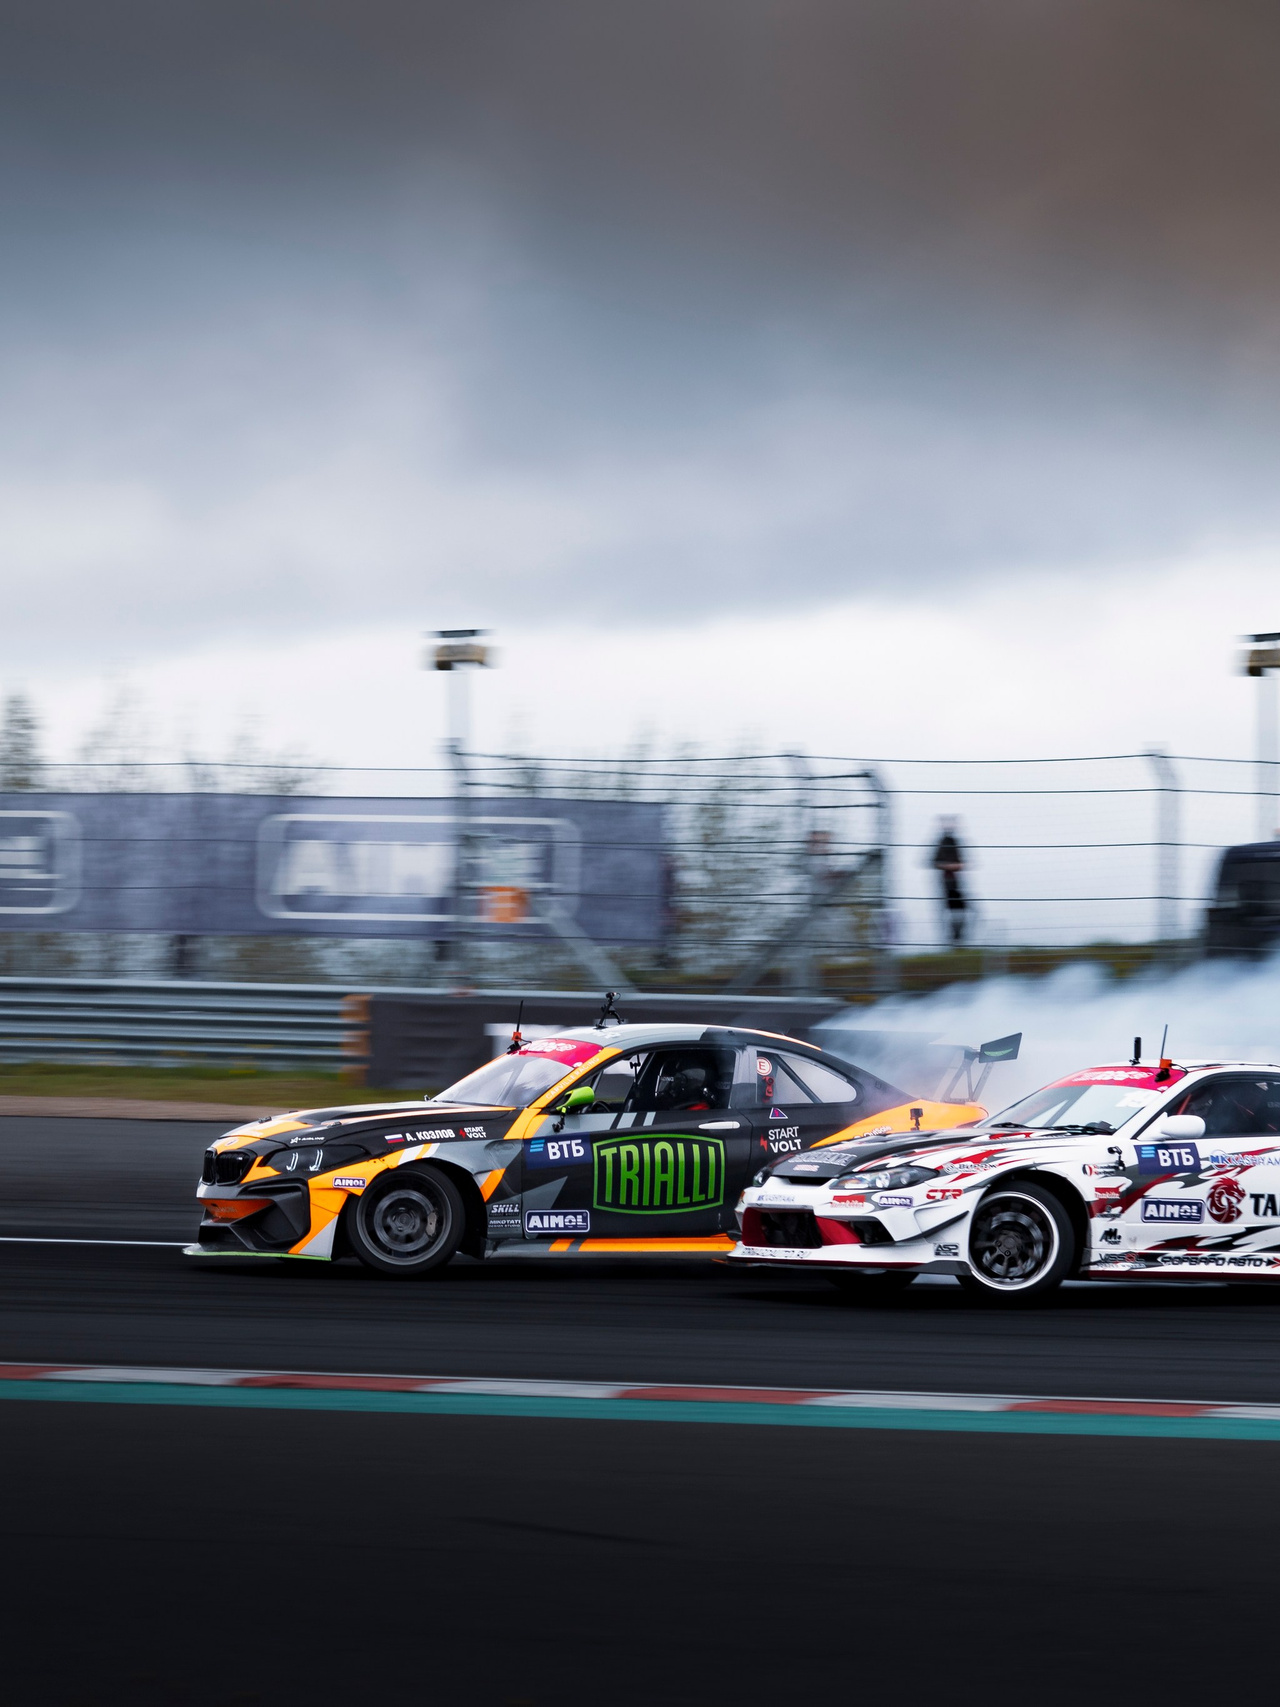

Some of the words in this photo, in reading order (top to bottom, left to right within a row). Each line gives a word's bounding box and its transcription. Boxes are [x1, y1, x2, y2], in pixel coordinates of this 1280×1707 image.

[759, 1061, 766, 1070] E
[545, 1075, 577, 1100] CARVILLE
[575, 1057, 600, 1077] RACING
[405, 1132, 416, 1142] А.
[417, 1129, 456, 1140] КОЗЛОВ
[467, 1131, 487, 1139] VOLT
[768, 1126, 800, 1141] START
[547, 1139, 585, 1160] ВТБ
[769, 1139, 802, 1153] VOLT
[1157, 1148, 1195, 1168] ВТБ
[600, 1141, 716, 1206] TRIALLI
[334, 1178, 365, 1188] AIMOL
[925, 1189, 963, 1200] CTR
[491, 1204, 520, 1213] SKILL
[880, 1197, 912, 1207] AIMOL
[1145, 1203, 1202, 1218] AIMOL
[528, 1214, 588, 1229] AIMOL
[936, 1244, 959, 1252] ASP
